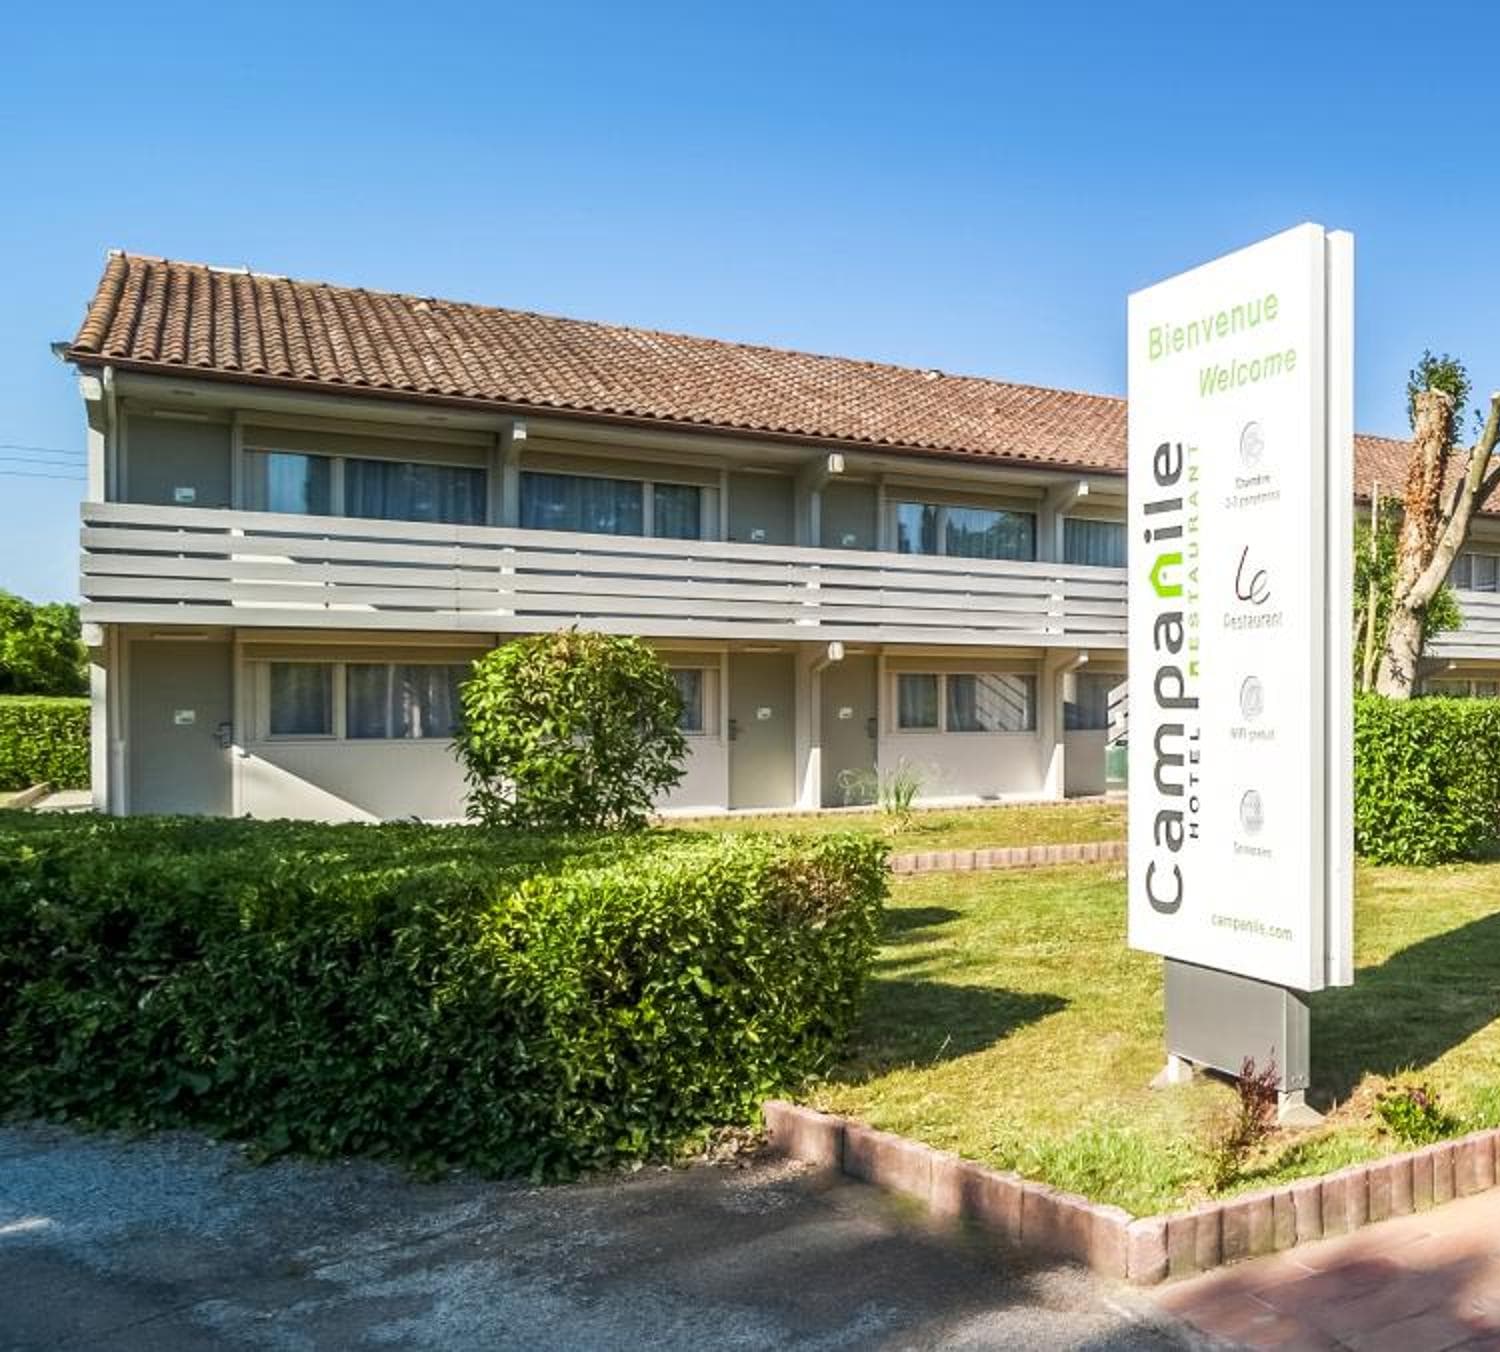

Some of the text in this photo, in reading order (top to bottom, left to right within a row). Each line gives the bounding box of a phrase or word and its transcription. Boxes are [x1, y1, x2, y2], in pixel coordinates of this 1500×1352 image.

[1149, 292, 1279, 361] Bienvenue
[1199, 348, 1297, 398] Welcome
[1187, 445, 1200, 839] HOTEL RESTAURANT
[1143, 441, 1199, 915] Campanile
[1211, 911, 1293, 942] campanile.com
